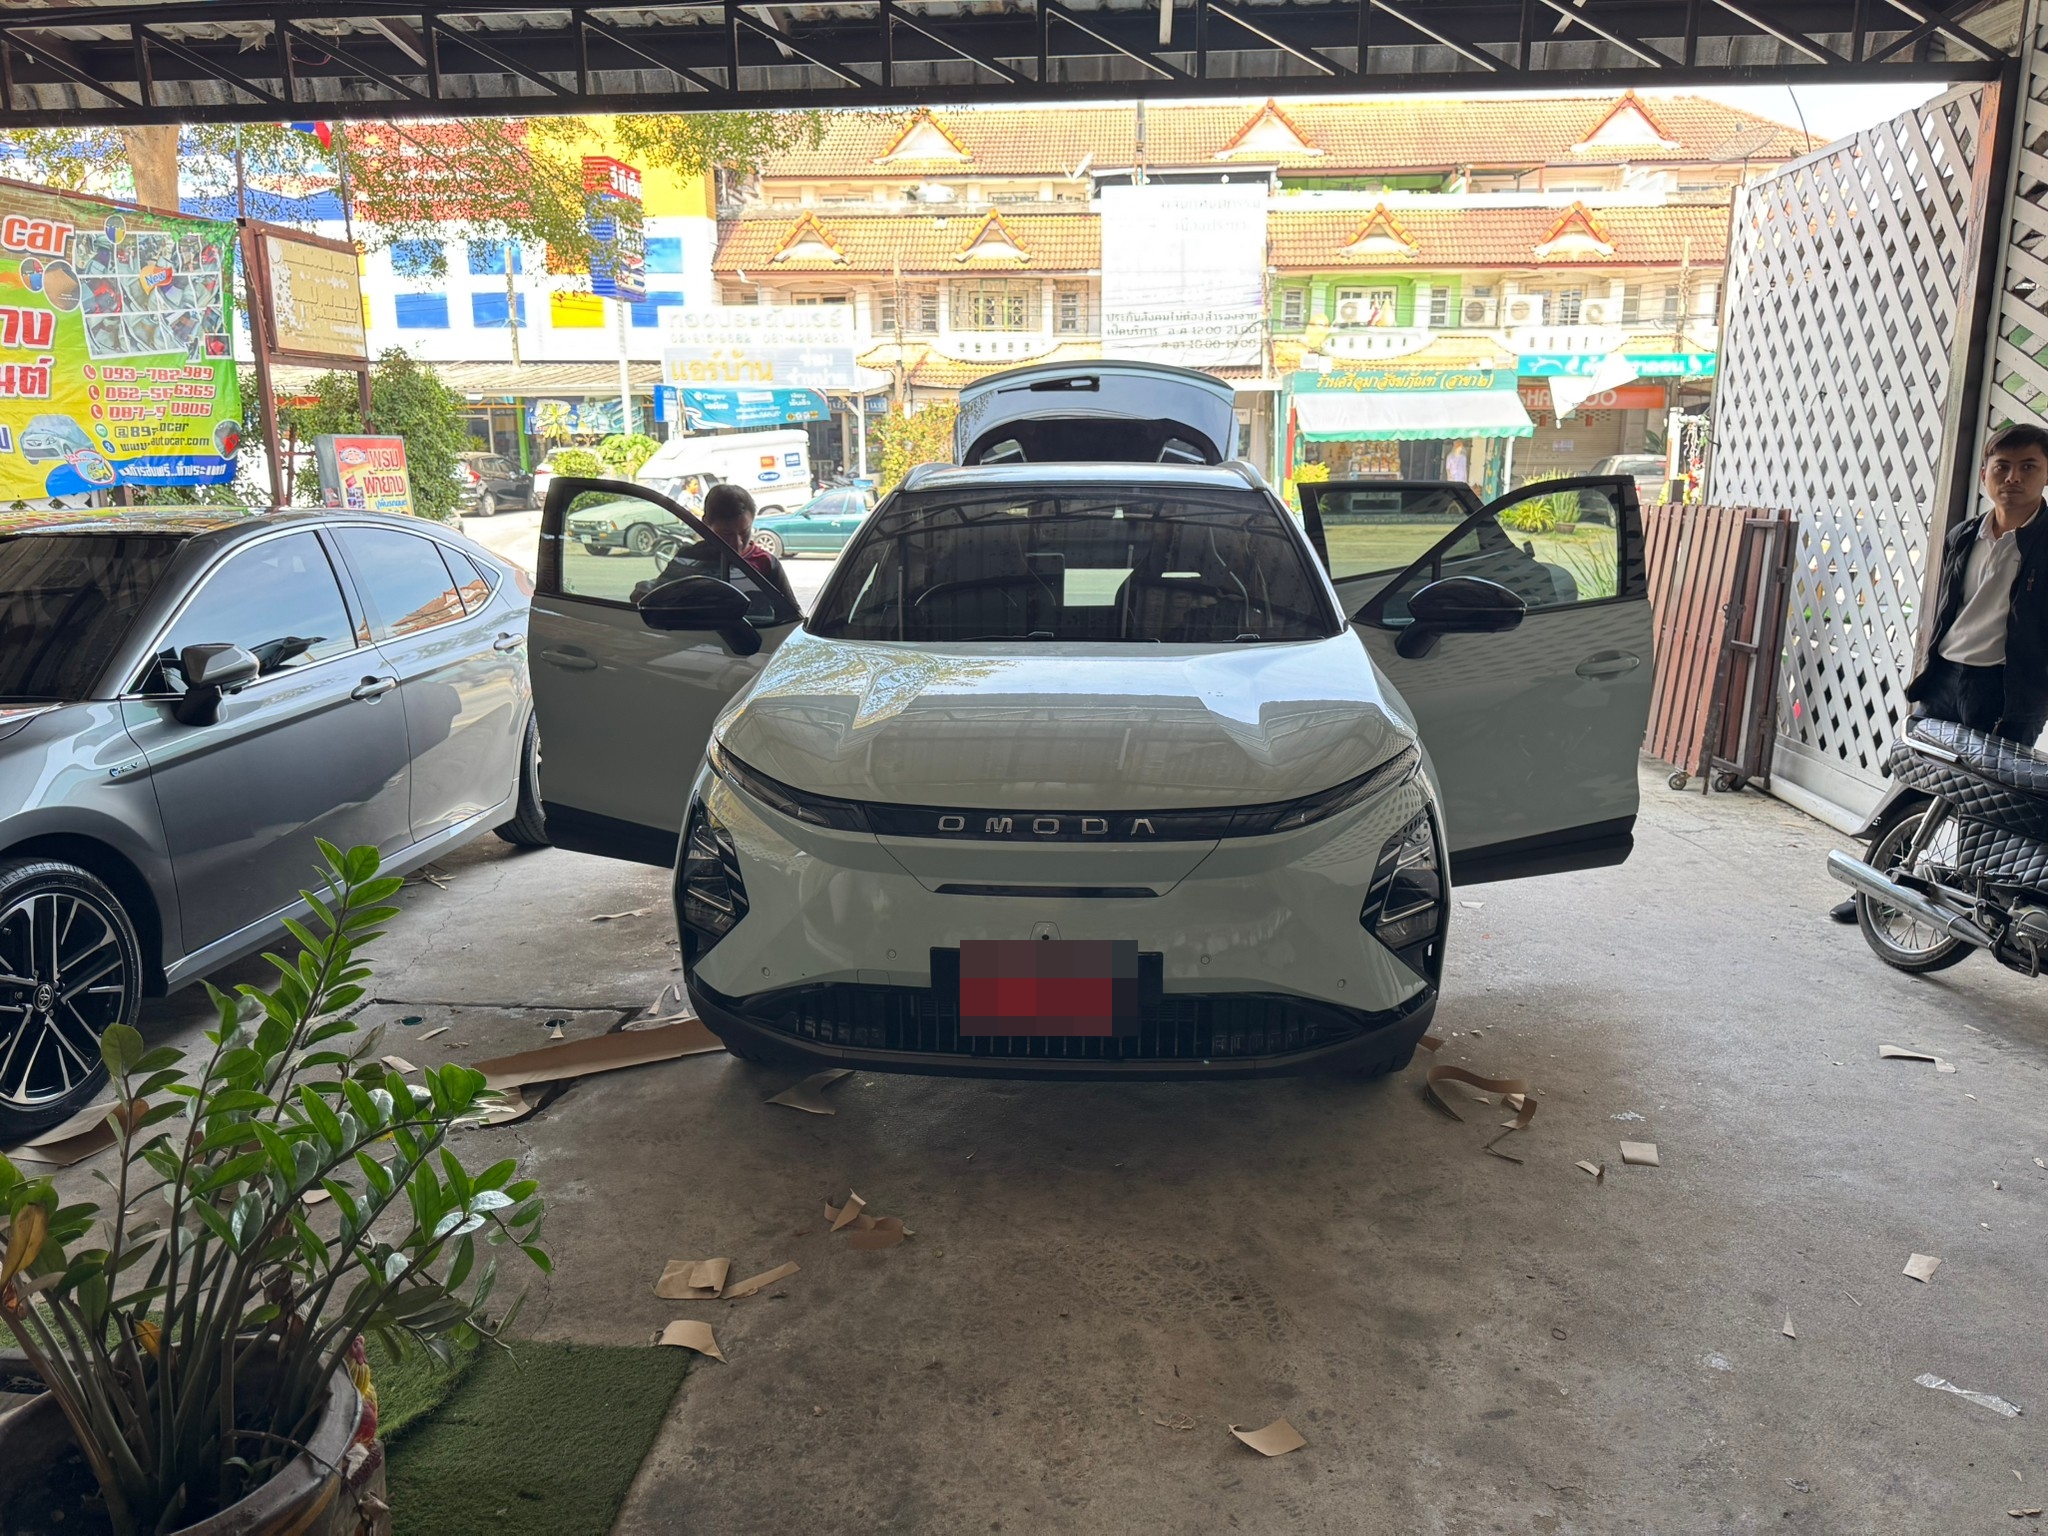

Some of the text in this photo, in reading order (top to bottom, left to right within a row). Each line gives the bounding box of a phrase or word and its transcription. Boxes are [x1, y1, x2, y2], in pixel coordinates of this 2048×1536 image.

[3, 217, 73, 254] car
[145, 270, 167, 286] New
[671, 350, 774, 382] แอร์บ้าน
[1519, 389, 1618, 407] SHAOO
[368, 449, 400, 469] พรม
[363, 470, 406, 496] ผ้ายาง
